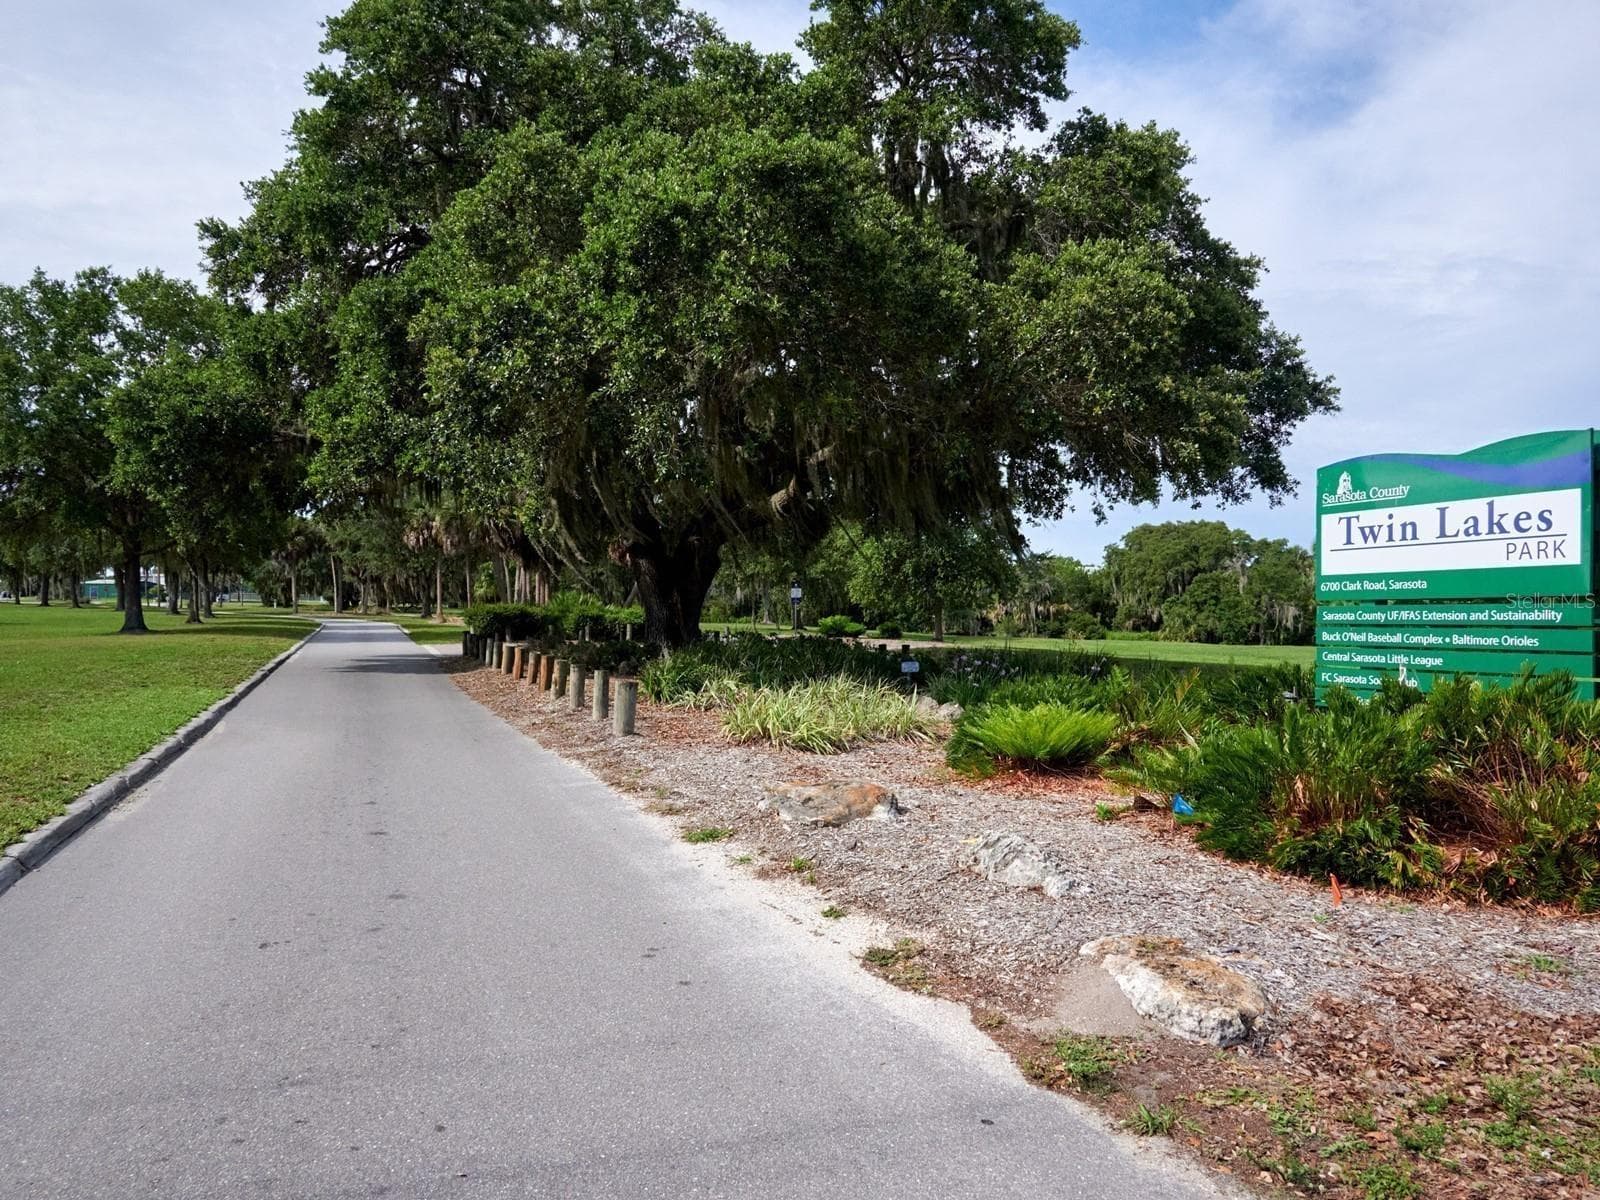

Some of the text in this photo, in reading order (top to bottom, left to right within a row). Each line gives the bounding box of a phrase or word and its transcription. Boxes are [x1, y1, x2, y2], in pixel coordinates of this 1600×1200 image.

[1322, 484, 1410, 504] Sarasota County
[1338, 500, 1553, 546] Twin Lakes
[1506, 540, 1566, 561] PARK
[1321, 579, 1427, 591] 6700 Clark Road, Sarasota
[1322, 609, 1563, 623] Sarasota County UF/IFAS Extension and Sustainability
[1322, 631, 1341, 642] Buck
[1367, 632, 1402, 643] Baseball
[1403, 633, 1444, 646] Complex
[1452, 634, 1500, 645] Baltimore
[1501, 635, 1539, 647] Orioles
[1322, 651, 1444, 668] Central Sarasota Little League
[1321, 672, 1332, 682] FC
[1333, 673, 1367, 685] Sarasota
